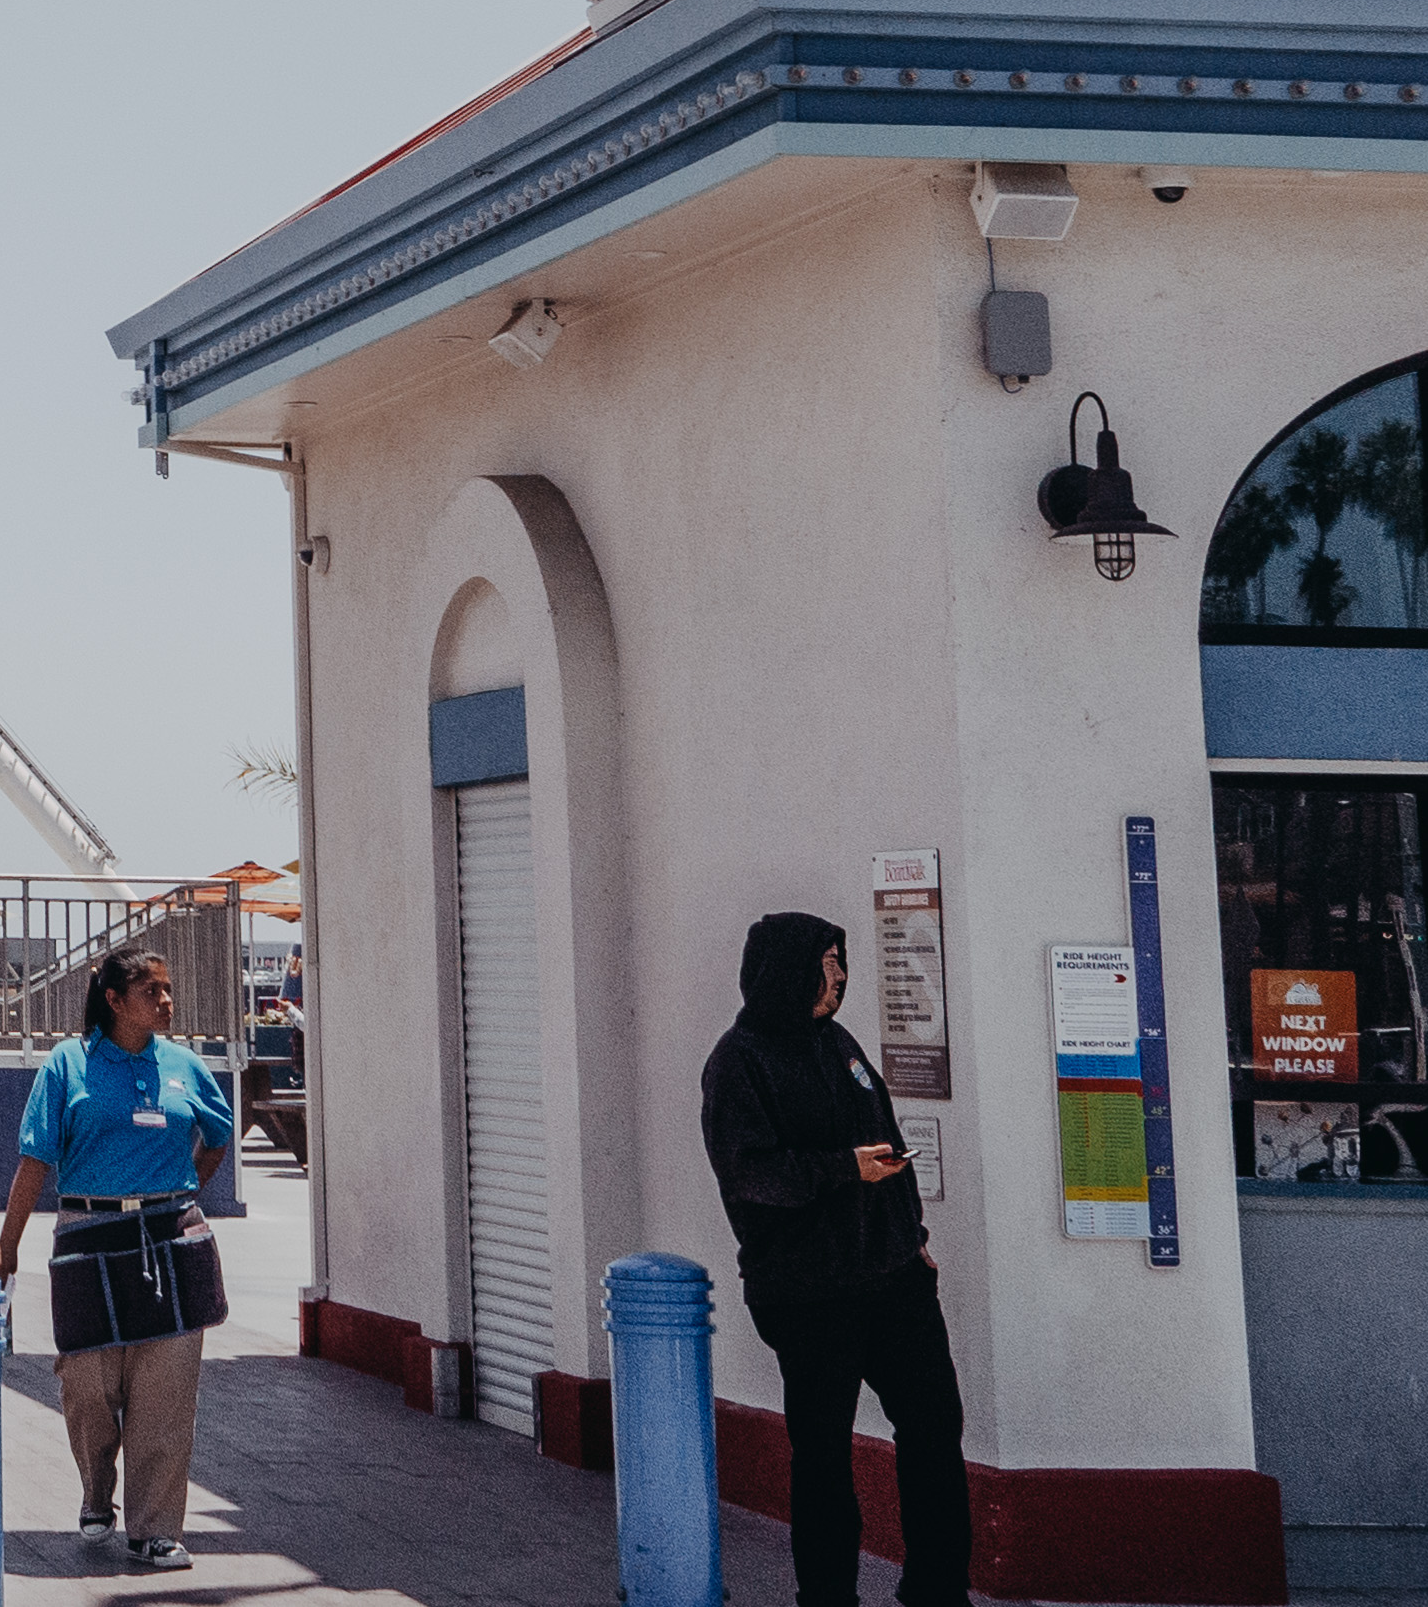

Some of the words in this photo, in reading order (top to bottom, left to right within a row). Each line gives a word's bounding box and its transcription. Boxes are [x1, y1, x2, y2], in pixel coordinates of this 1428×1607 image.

[1063, 952, 1084, 960] RIDE
[1087, 953, 1122, 961] HEIGHT
[1056, 962, 1130, 971] REQUIREMENTS
[1281, 1015, 1326, 1031] NEXT
[1262, 1036, 1346, 1053] WINDOW
[1274, 1058, 1335, 1074] PLEASE
